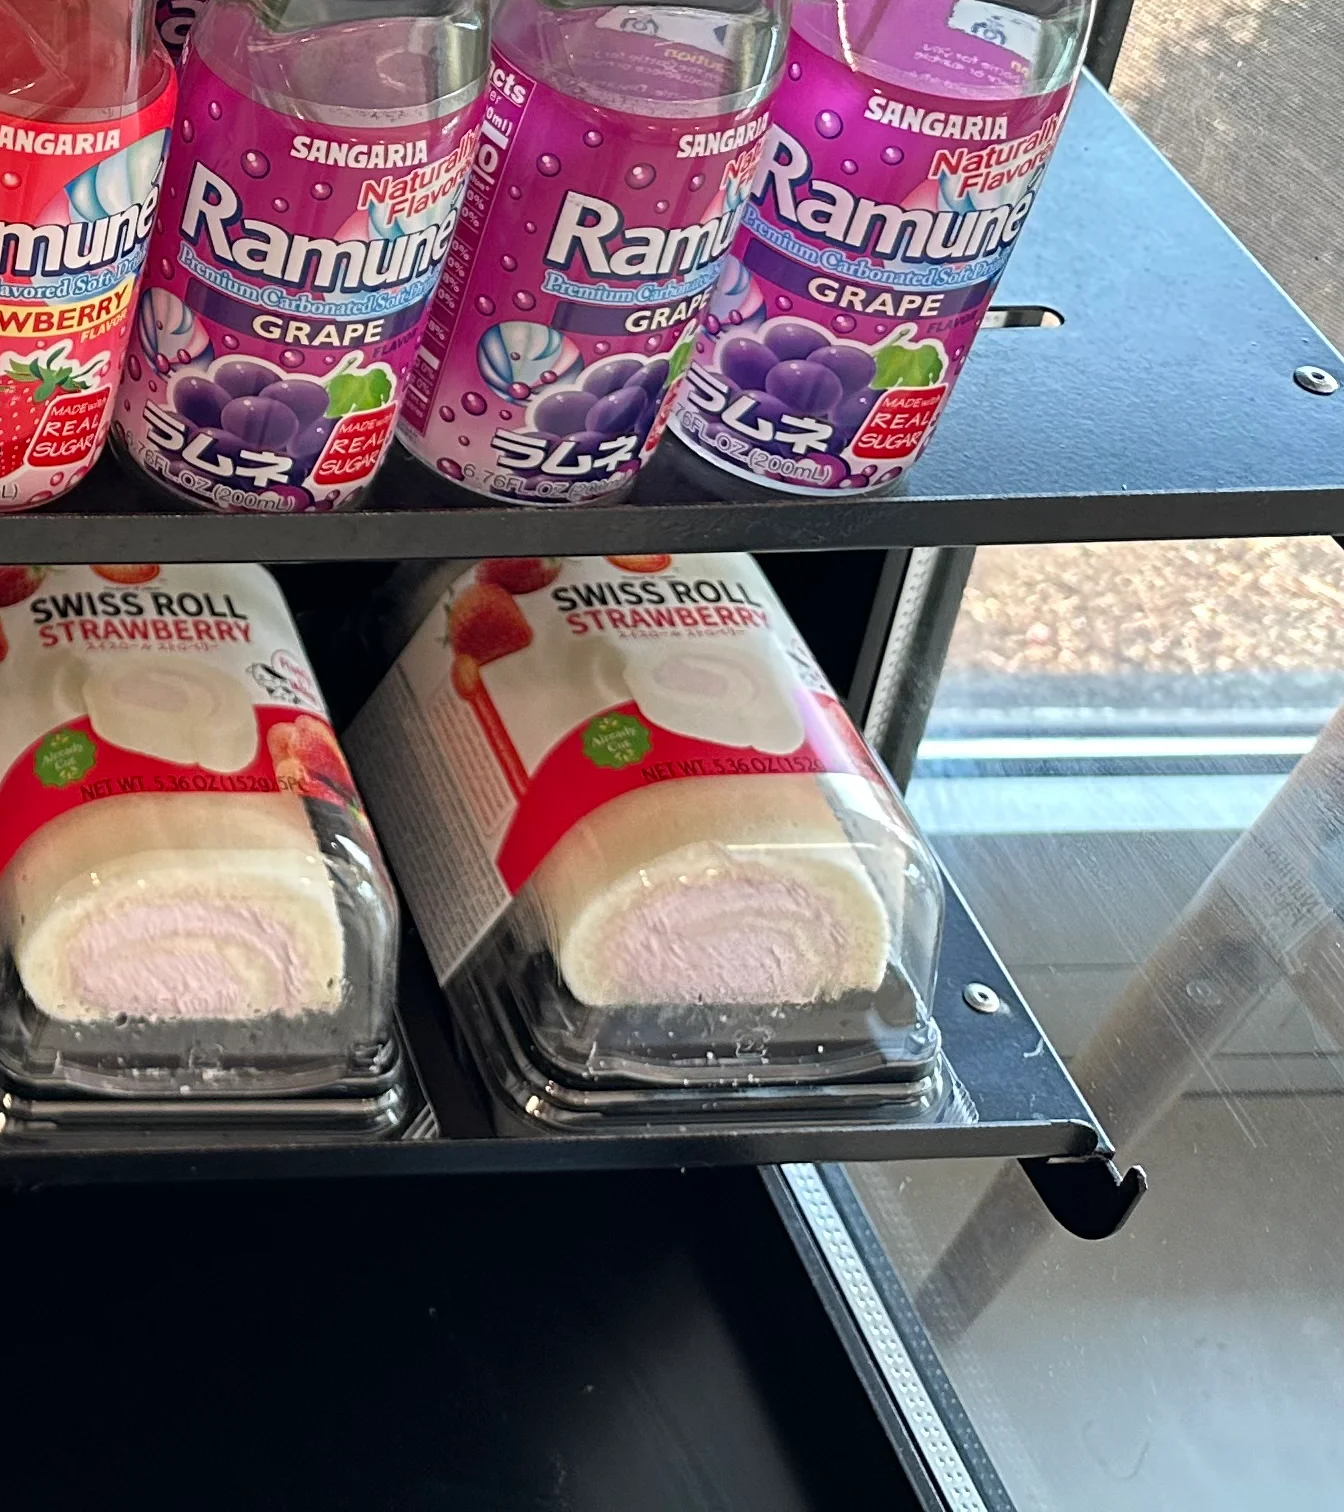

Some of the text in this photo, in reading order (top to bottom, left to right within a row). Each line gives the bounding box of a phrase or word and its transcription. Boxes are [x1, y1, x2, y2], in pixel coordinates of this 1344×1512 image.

[676, 111, 769, 160] SANGARIA
[863, 95, 1008, 141] SANGARIA
[290, 135, 429, 170] SANGARIA
[931, 111, 1061, 178] Naturally
[748, 122, 1044, 264] Ramuné
[179, 160, 459, 294] Ramuné
[178, 242, 375, 318] Premium Carbonated
[807, 277, 945, 317] GRAPE
[252, 317, 386, 348] GRAPE
[624, 288, 712, 335] GRAPE
[491, 425, 640, 477] ラムネ
[30, 591, 248, 625] SWISS ROLL
[552, 579, 762, 612] SWISS ROLL
[38, 618, 252, 648] STRAWBERRY
[565, 606, 770, 635] STRAWBERRY
